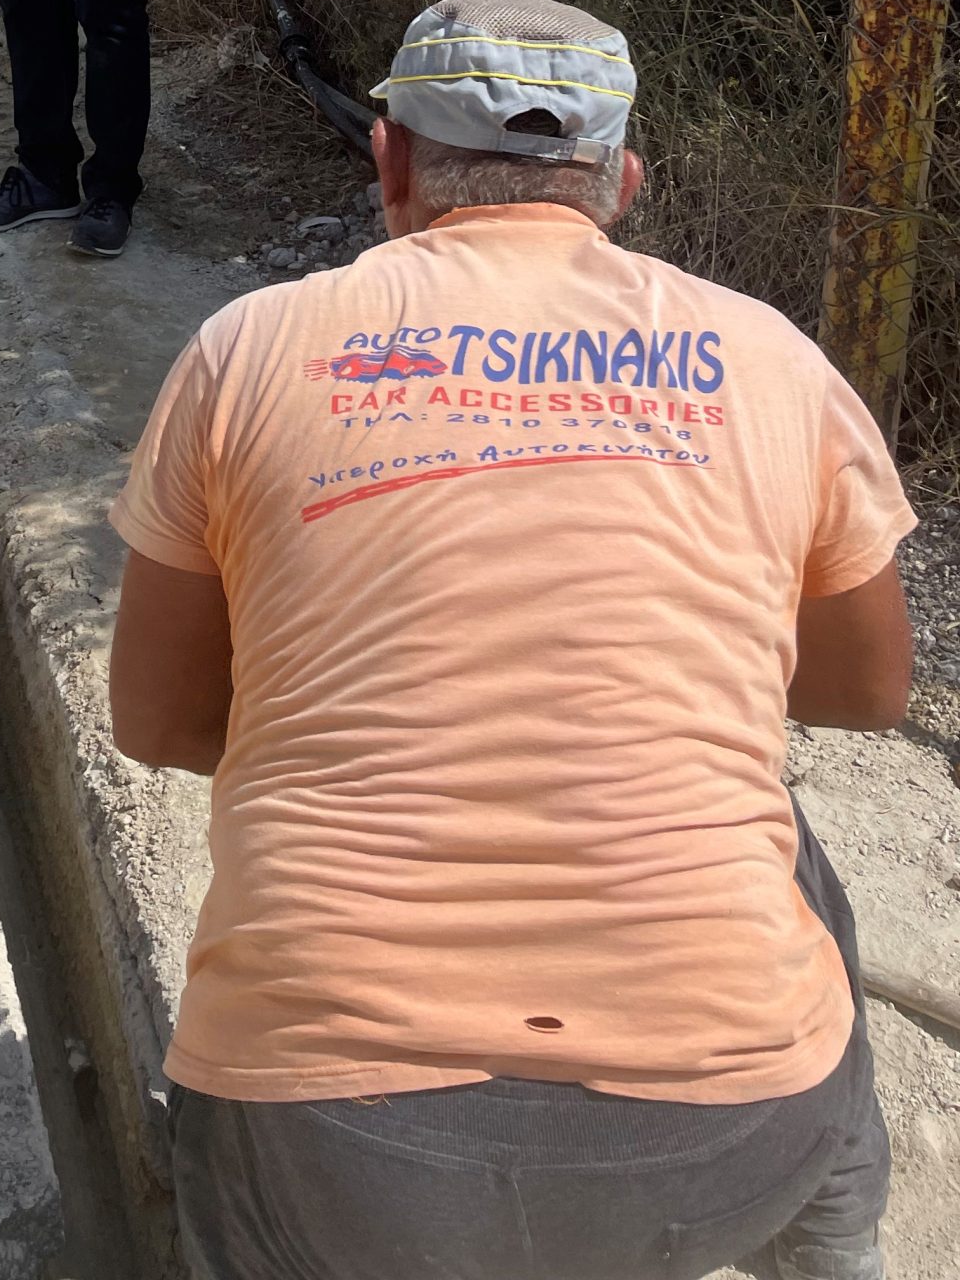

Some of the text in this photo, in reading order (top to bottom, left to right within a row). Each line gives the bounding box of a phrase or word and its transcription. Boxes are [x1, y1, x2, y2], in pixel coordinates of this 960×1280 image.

[343, 325, 724, 394] AUTO TSIKNAKIS
[331, 386, 723, 426] CAR ACCESSORIES
[447, 413, 540, 428] 2810
